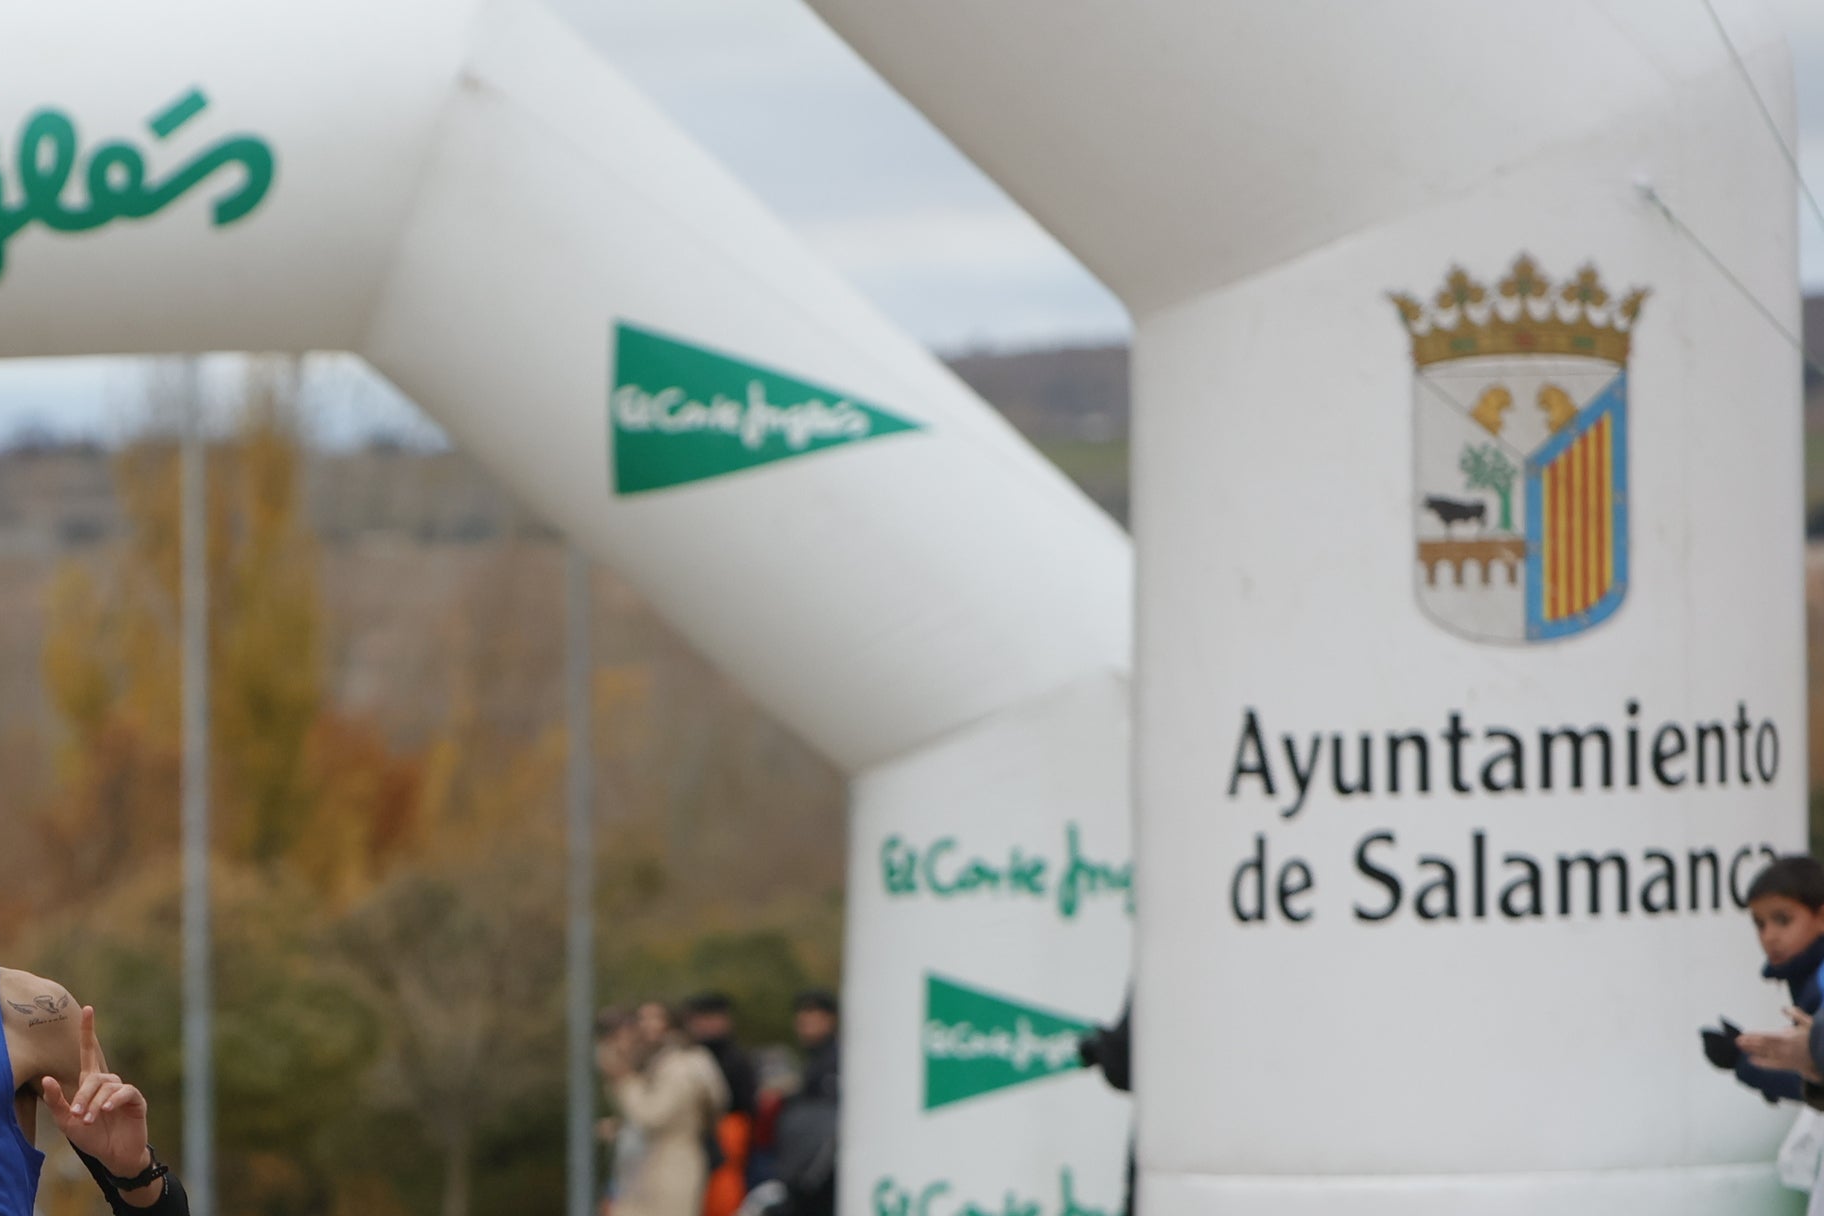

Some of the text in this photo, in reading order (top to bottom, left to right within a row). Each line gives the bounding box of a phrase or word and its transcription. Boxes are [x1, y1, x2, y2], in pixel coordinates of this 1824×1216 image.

[1228, 699, 1781, 820] Ayuntamiento
[882, 834, 918, 896] El
[924, 835, 1049, 897] Corte
[1231, 833, 1314, 923] de
